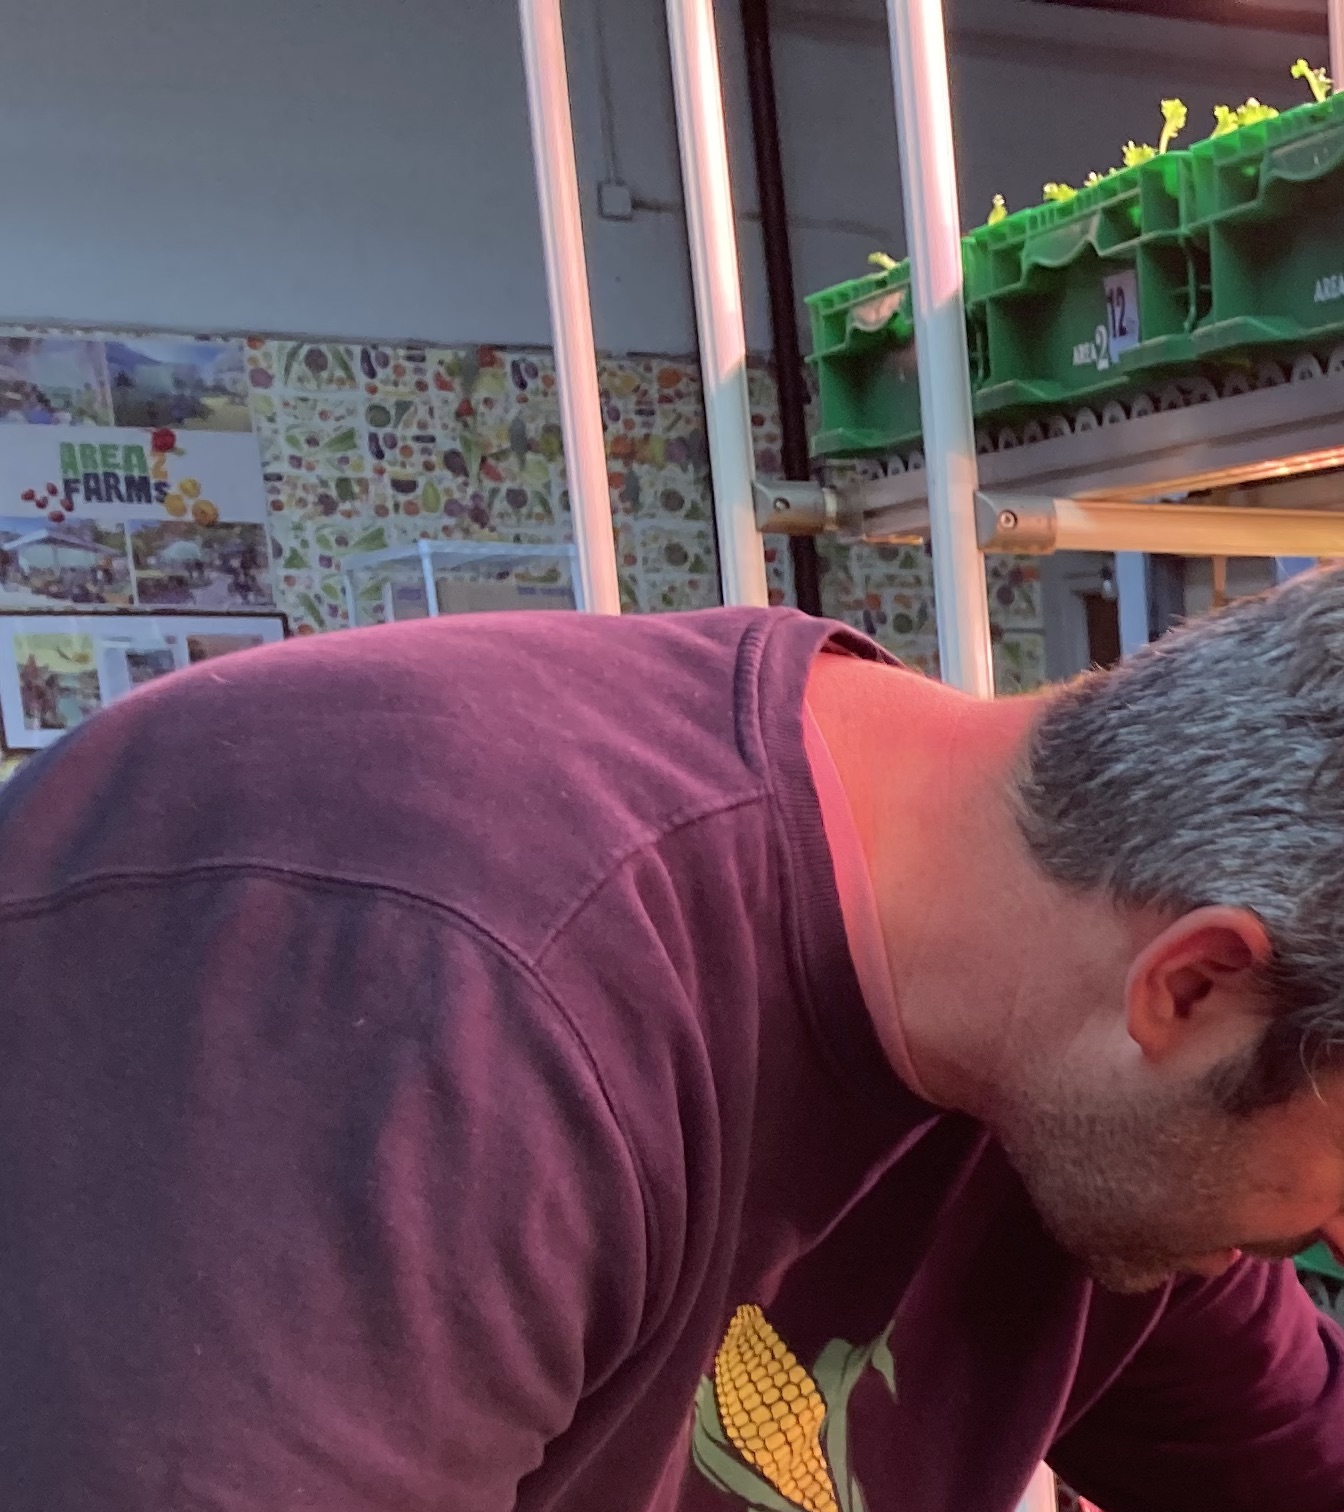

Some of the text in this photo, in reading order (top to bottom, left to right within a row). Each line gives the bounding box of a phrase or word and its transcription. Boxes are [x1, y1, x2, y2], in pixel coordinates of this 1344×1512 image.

[1106, 286, 1128, 339] 12
[1095, 324, 1110, 371] 2
[60, 441, 168, 480] AREA 2
